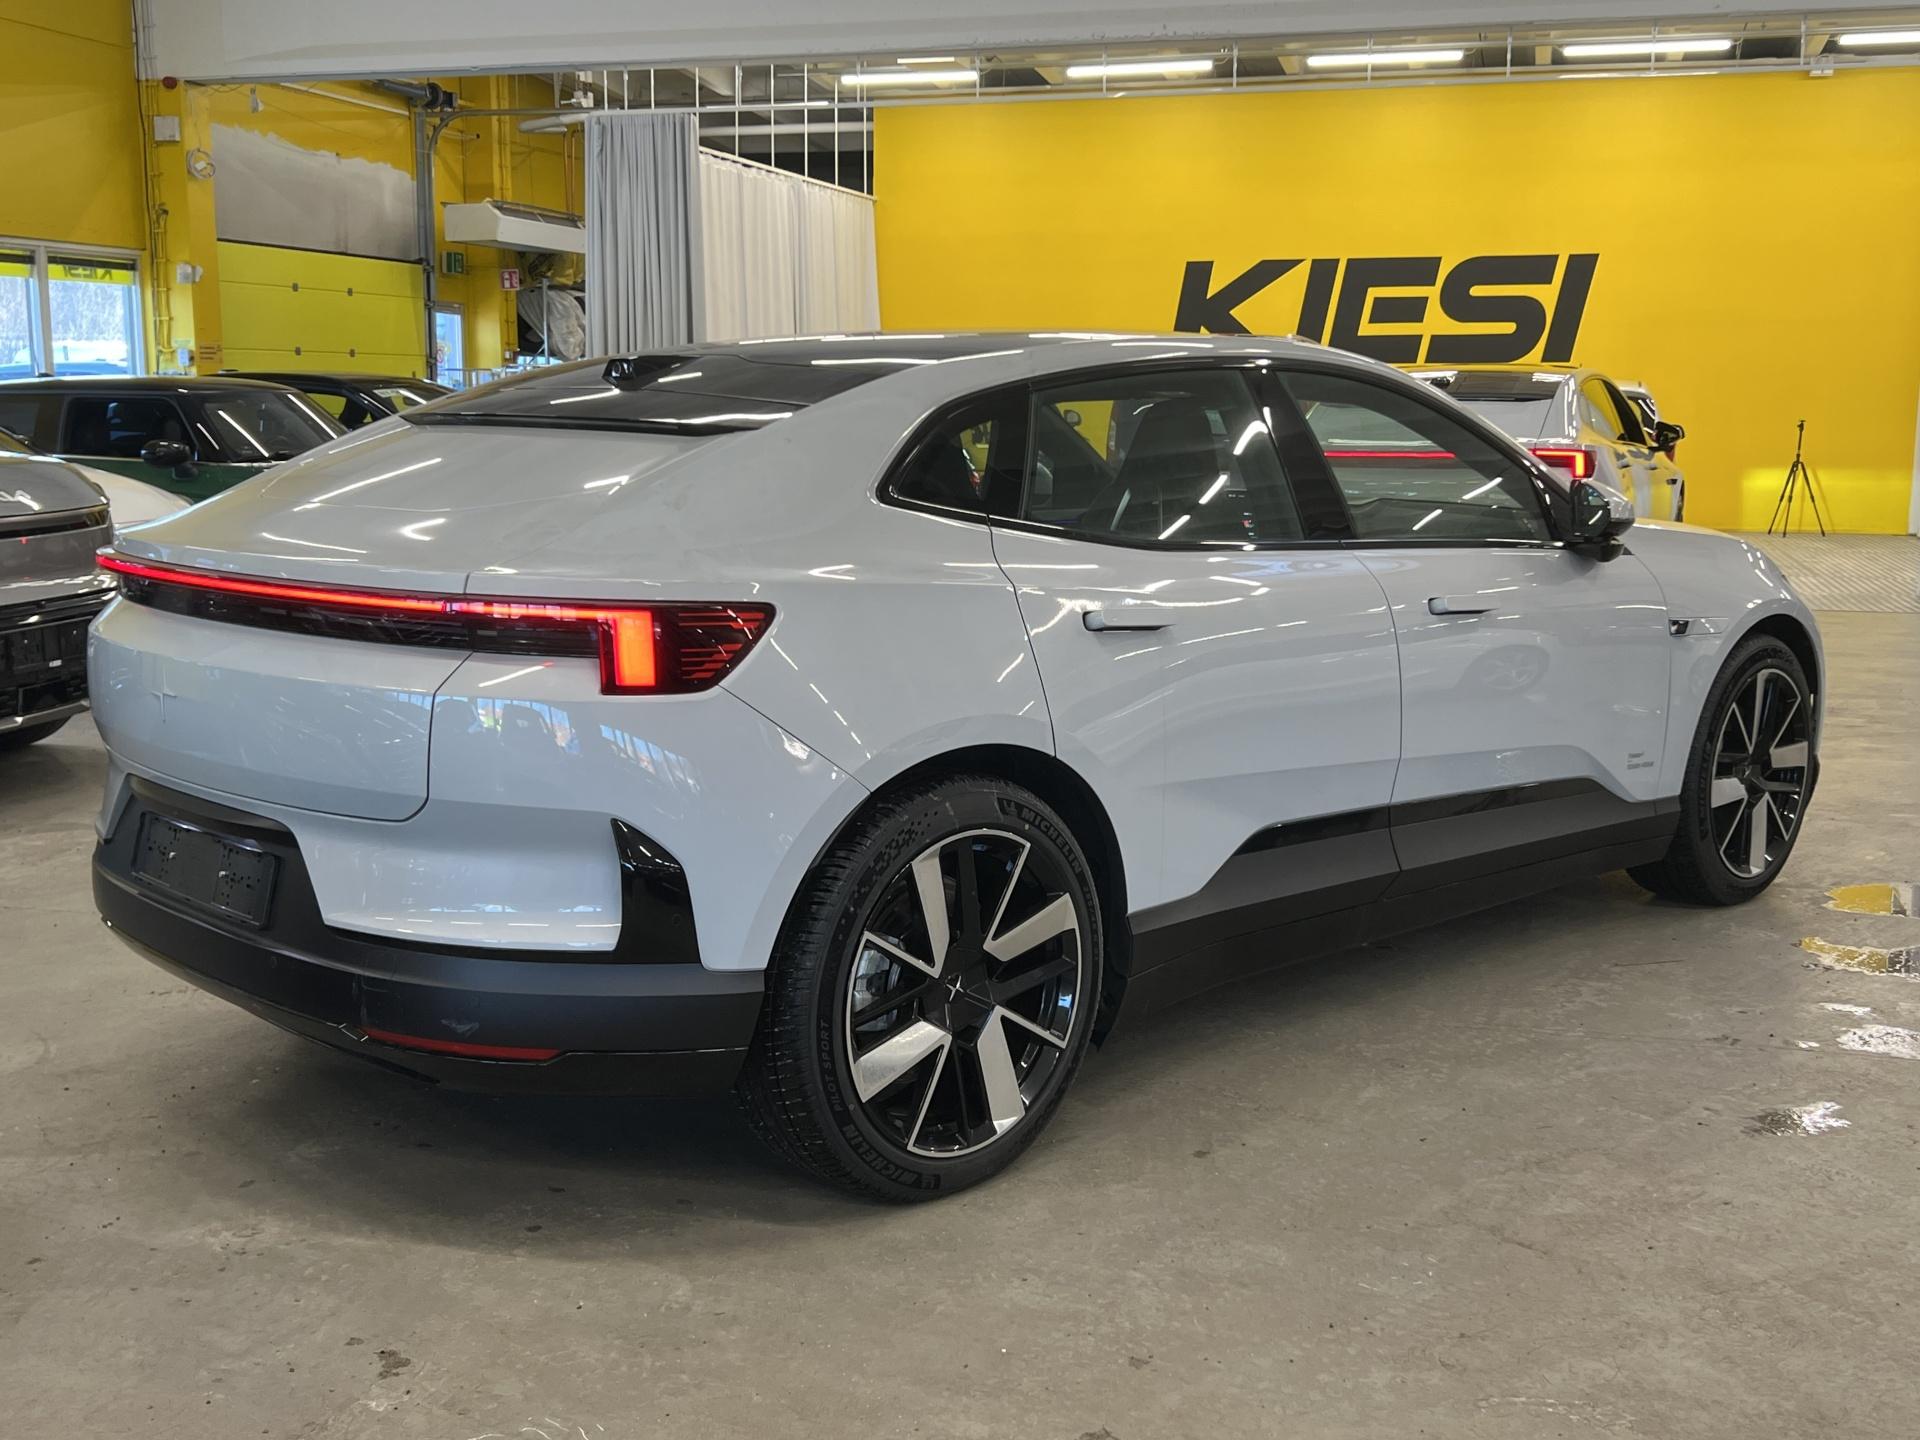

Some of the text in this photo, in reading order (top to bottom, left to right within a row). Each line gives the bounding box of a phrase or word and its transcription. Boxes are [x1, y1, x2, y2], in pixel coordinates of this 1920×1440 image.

[1173, 253, 1600, 364] KIESI
[1021, 808, 1083, 875] MICHELIN
[819, 1018, 834, 1069] SPORT
[824, 1071, 843, 1112] PILOT
